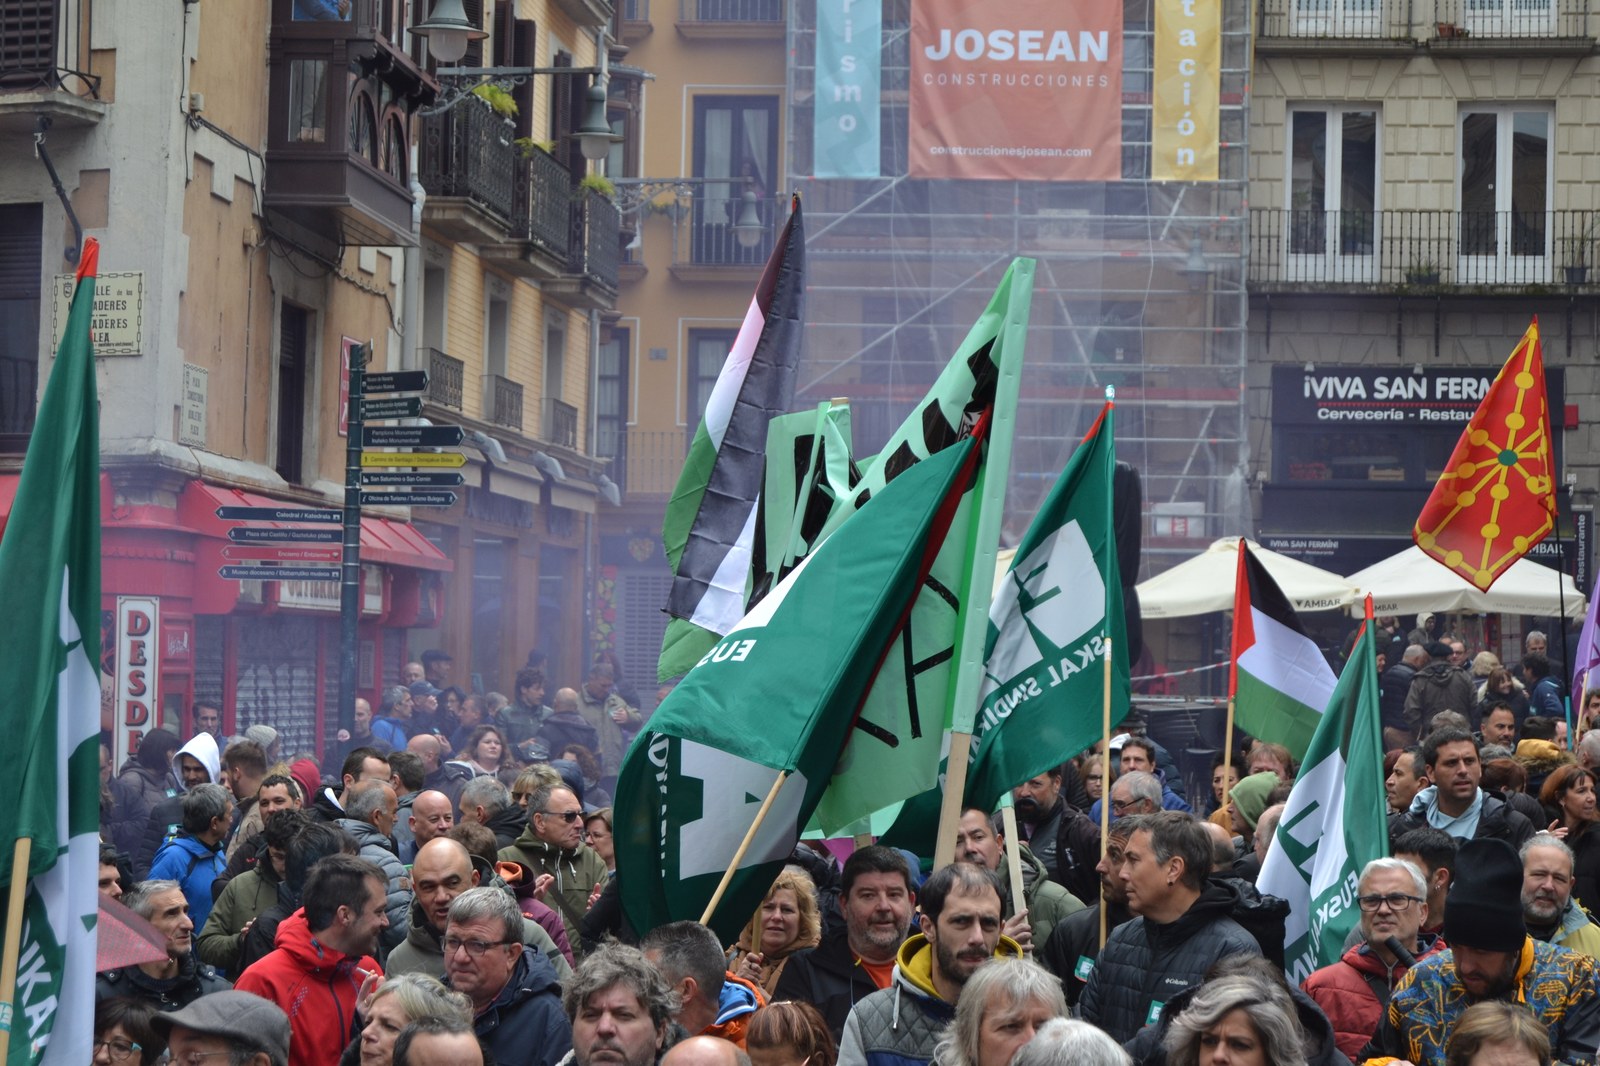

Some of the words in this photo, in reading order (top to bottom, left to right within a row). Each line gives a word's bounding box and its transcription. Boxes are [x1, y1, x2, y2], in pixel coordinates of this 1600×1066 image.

[924, 28, 1109, 63] JOSEAN
[923, 73, 1109, 88] CONSTRUCCIONES
[930, 144, 1093, 160] construccionesjosean.com
[92, 318, 128, 329] ADERES
[93, 332, 110, 343] LEA
[1373, 377, 1427, 400] SAN
[1317, 407, 1405, 421] Cervecería
[276, 511, 299, 519] Catedral
[304, 512, 331, 520] Katedrala
[1291, 540, 1307, 549] SAN
[1576, 514, 1586, 582] Restaurante
[1304, 599, 1341, 609] AMBAR
[1374, 603, 1398, 612] MBAR
[124, 609, 151, 758] DESDE
